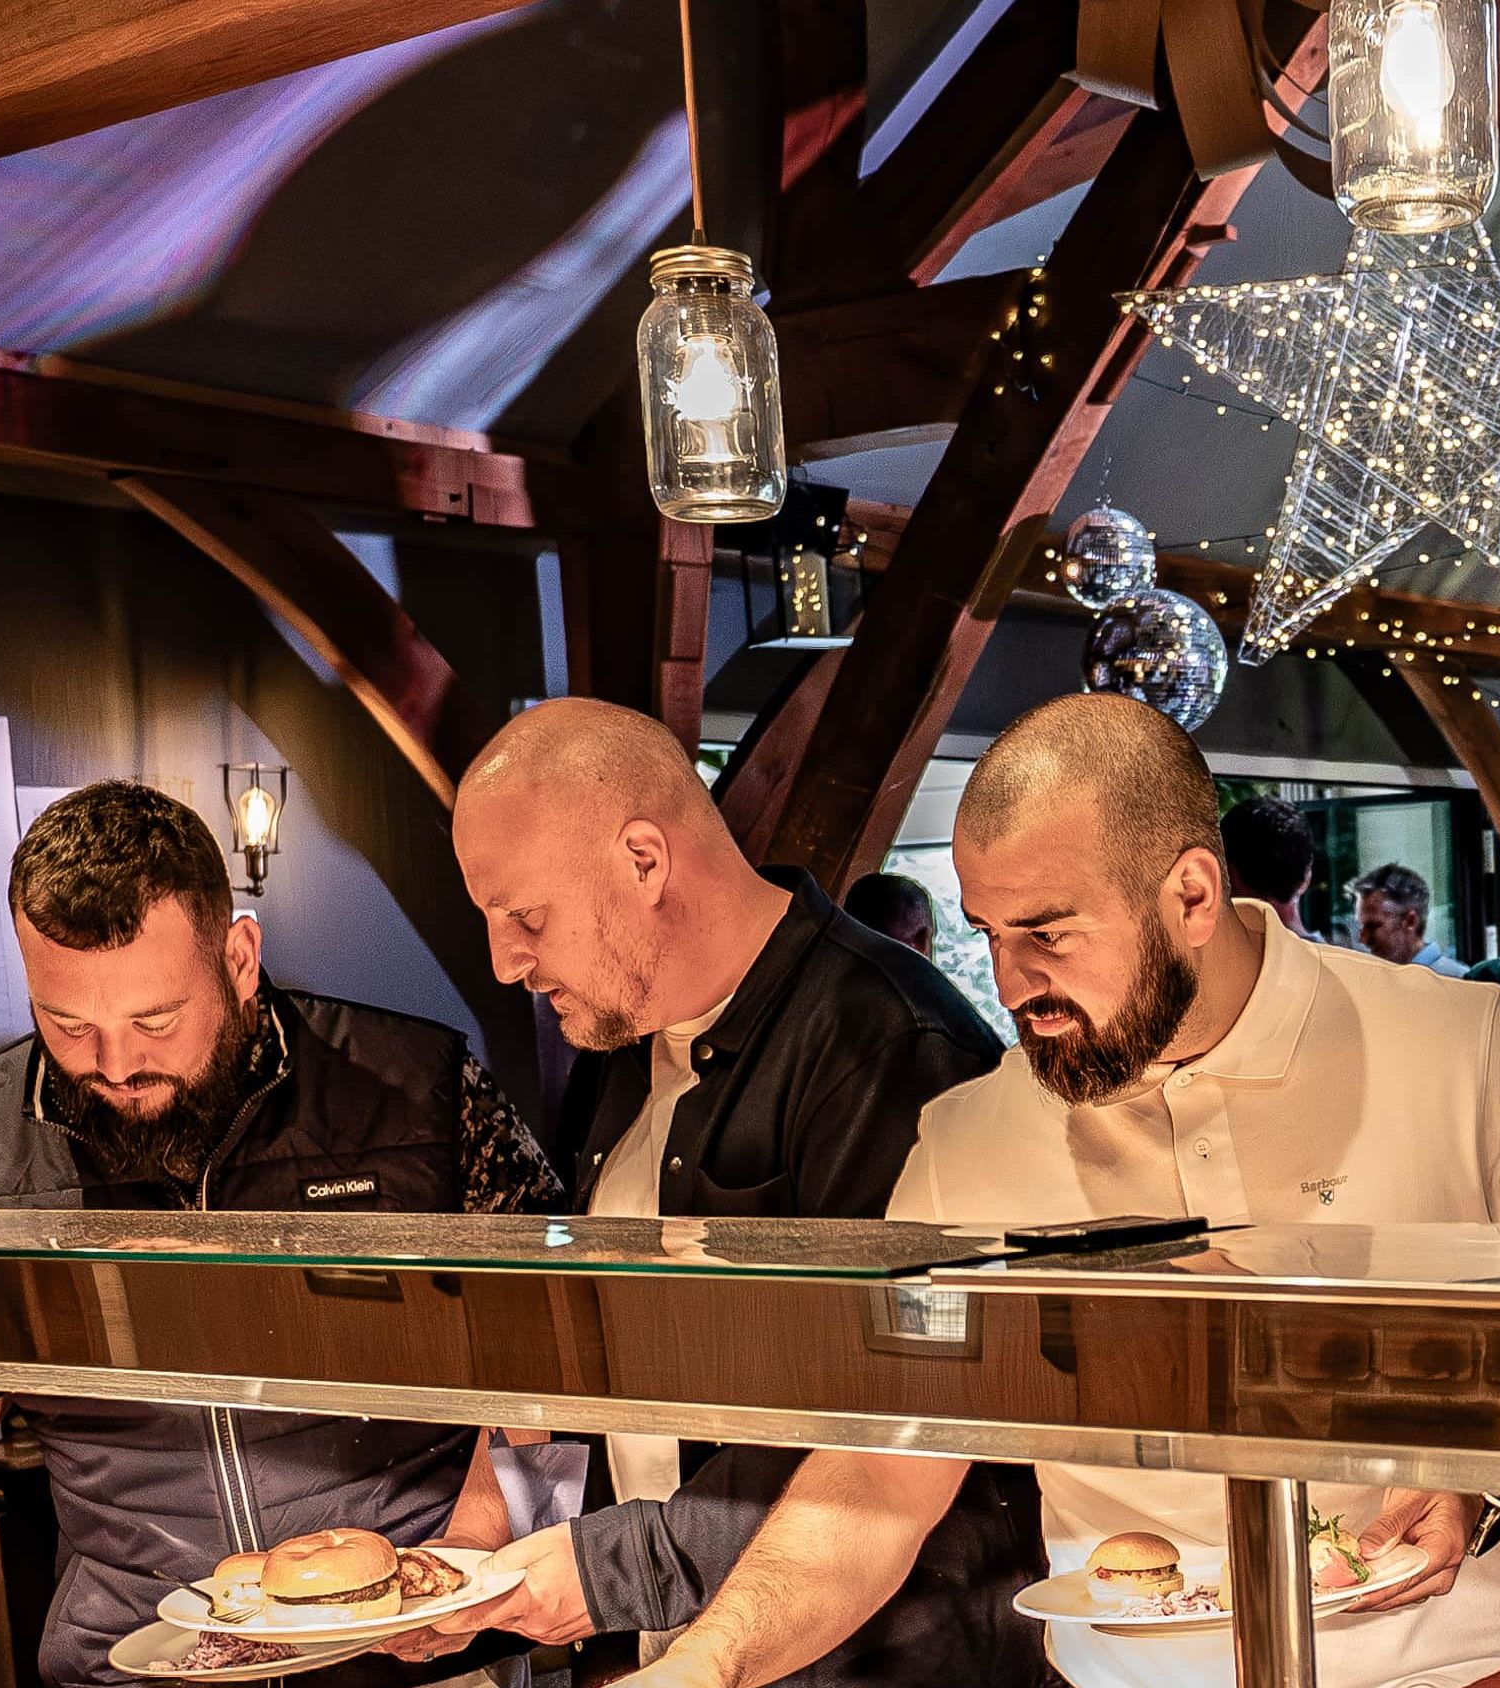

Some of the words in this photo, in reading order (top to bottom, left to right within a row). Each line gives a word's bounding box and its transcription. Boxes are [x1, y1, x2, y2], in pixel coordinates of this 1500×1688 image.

[307, 1183, 345, 1198] Calvin
[346, 1179, 375, 1194] Klein
[1300, 1175, 1348, 1193] Barbour
